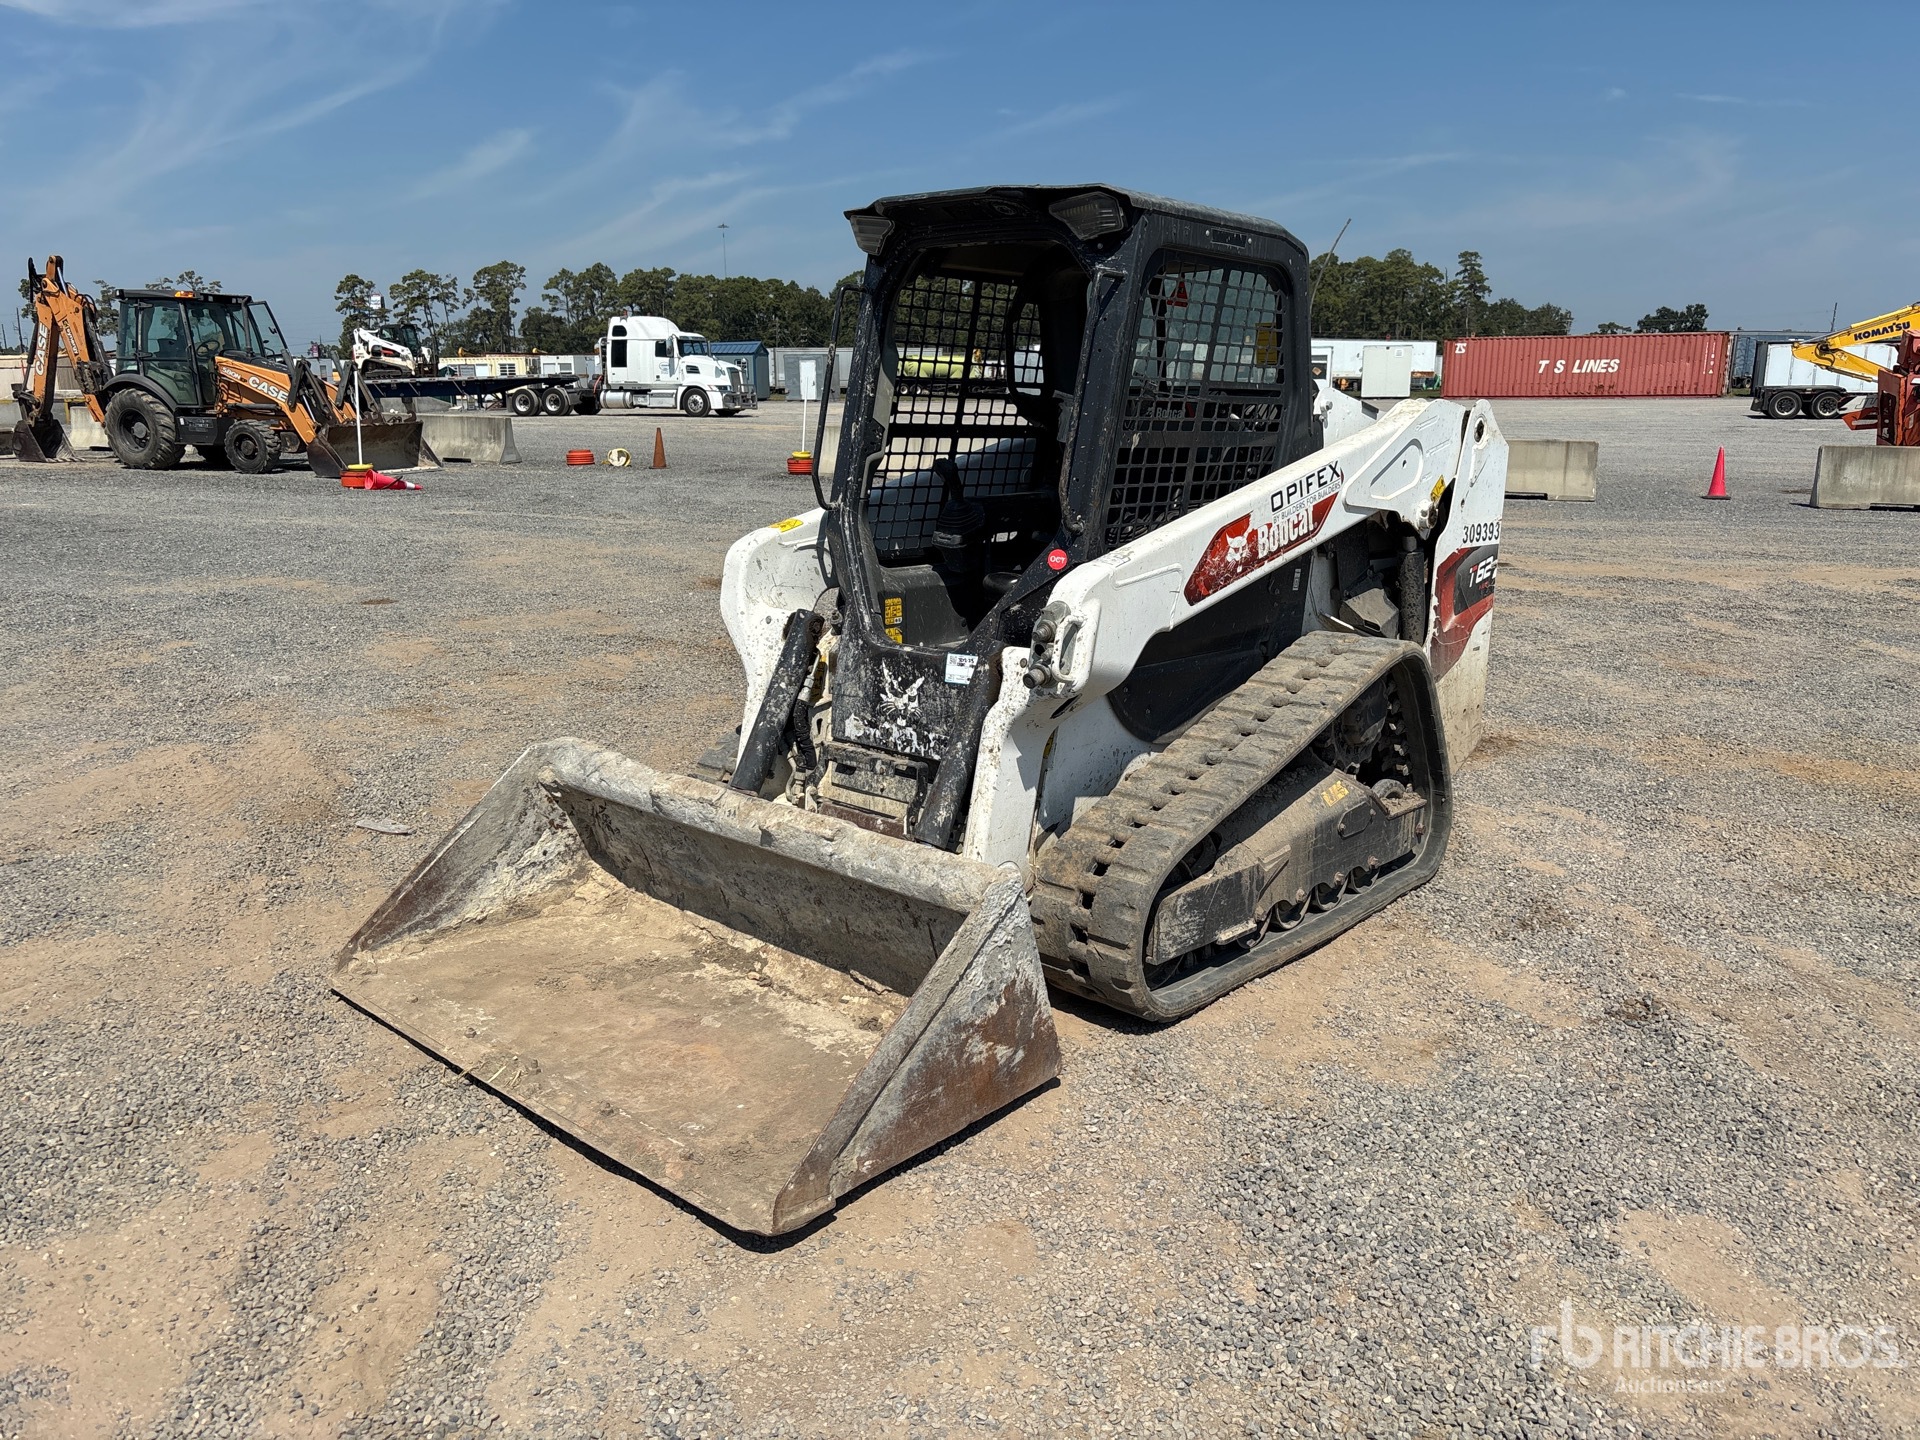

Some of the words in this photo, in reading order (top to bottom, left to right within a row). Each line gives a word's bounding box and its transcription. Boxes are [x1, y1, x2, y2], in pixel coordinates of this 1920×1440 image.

[1853, 321, 1911, 341] KOMATSU
[35, 322, 48, 376] CASE
[1537, 360, 1550, 374] T
[1553, 360, 1566, 374] S
[1572, 359, 1620, 374] LINES
[248, 376, 289, 403] CASE
[1155, 406, 1184, 419] Boca
[1270, 460, 1341, 513] OPIFEX
[1273, 513, 1281, 525] BY
[1281, 501, 1306, 521] BUILDERS
[1306, 495, 1318, 507] FOR
[1318, 482, 1341, 501] BUILDERS
[1257, 507, 1315, 559] Bobcat
[1462, 521, 1501, 544] 309393
